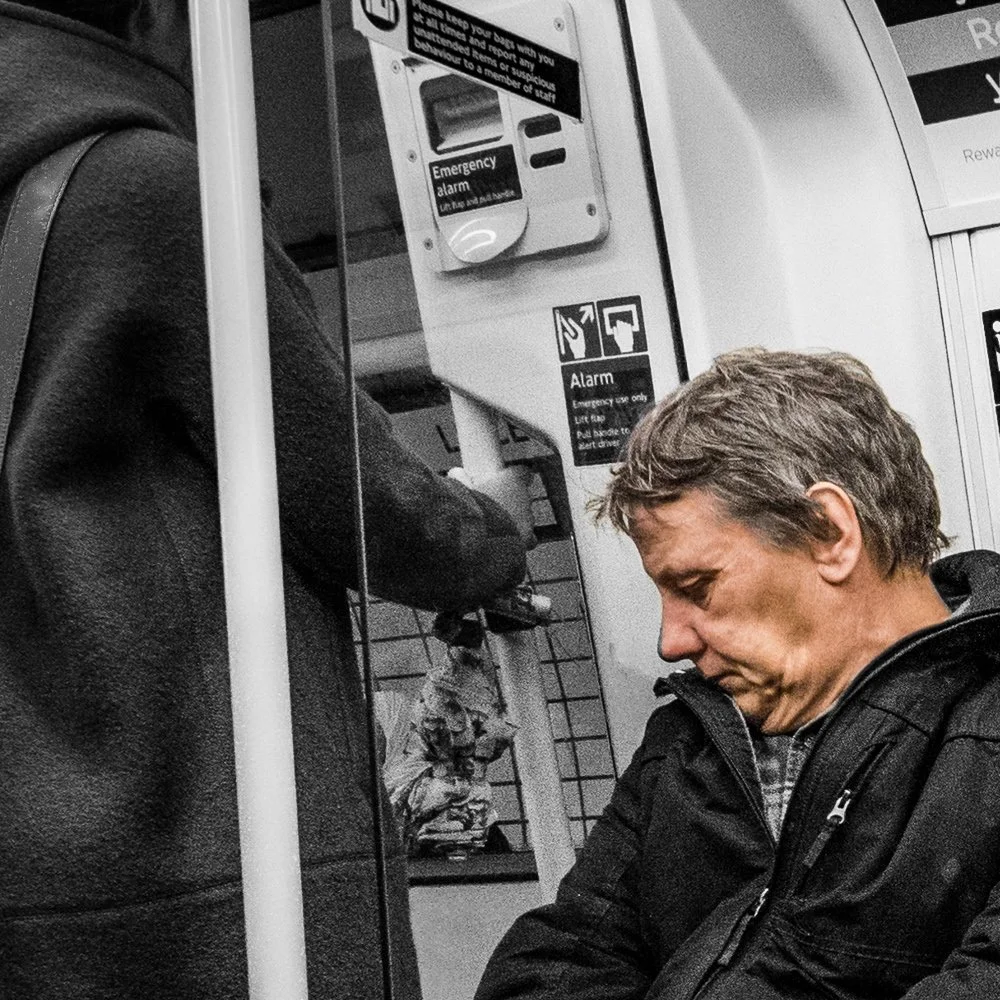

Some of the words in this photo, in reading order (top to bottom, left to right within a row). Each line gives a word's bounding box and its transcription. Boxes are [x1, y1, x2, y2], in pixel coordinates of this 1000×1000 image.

[413, 12, 424, 24] at
[426, 17, 438, 30] all
[440, 22, 466, 42] times
[469, 35, 486, 50] and
[488, 44, 516, 63] report
[519, 57, 535, 72] any
[446, 10, 469, 31] keep
[471, 23, 492, 39] your
[493, 32, 515, 50] bags
[517, 42, 537, 58] with
[538, 52, 555, 67] you
[413, 26, 470, 57] unattended
[472, 48, 497, 68] items
[500, 62, 509, 72] or
[511, 66, 556, 92] suspicious
[413, 36, 461, 65] behaviour
[463, 58, 474, 71] to
[484, 69, 521, 91] member
[523, 81, 533, 94] of
[534, 88, 556, 104] staff
[432, 156, 496, 179] Emergency
[437, 181, 470, 197] alarm
[570, 371, 614, 389] Alarm
[572, 397, 613, 409] Emergency
[615, 395, 629, 404] use
[631, 392, 648, 404] only
[574, 415, 589, 425] Lift
[576, 430, 591, 440] Pull
[593, 428, 619, 438] handle
[620, 427, 630, 435] to
